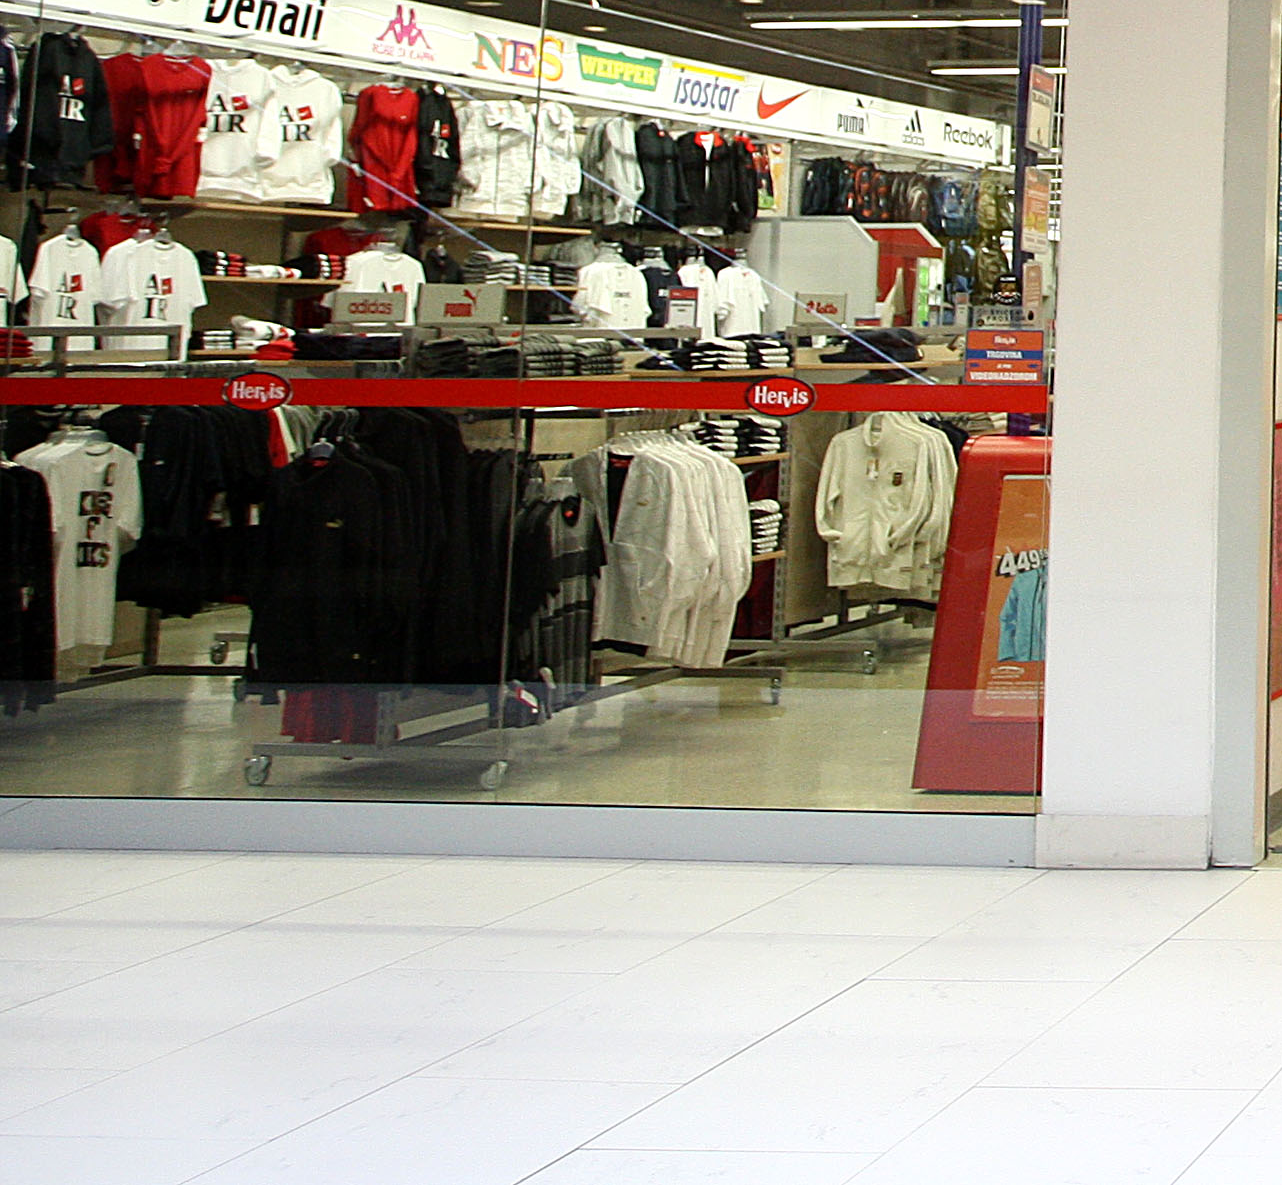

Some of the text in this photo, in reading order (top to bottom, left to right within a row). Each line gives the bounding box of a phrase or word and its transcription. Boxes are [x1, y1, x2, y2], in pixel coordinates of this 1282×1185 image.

[471, 31, 565, 82] NES
[580, 54, 656, 87] WEIPPER
[673, 67, 740, 113] isostar
[943, 122, 994, 150] Reebok
[232, 381, 286, 403] Hervis
[754, 387, 810, 408] Hervis
